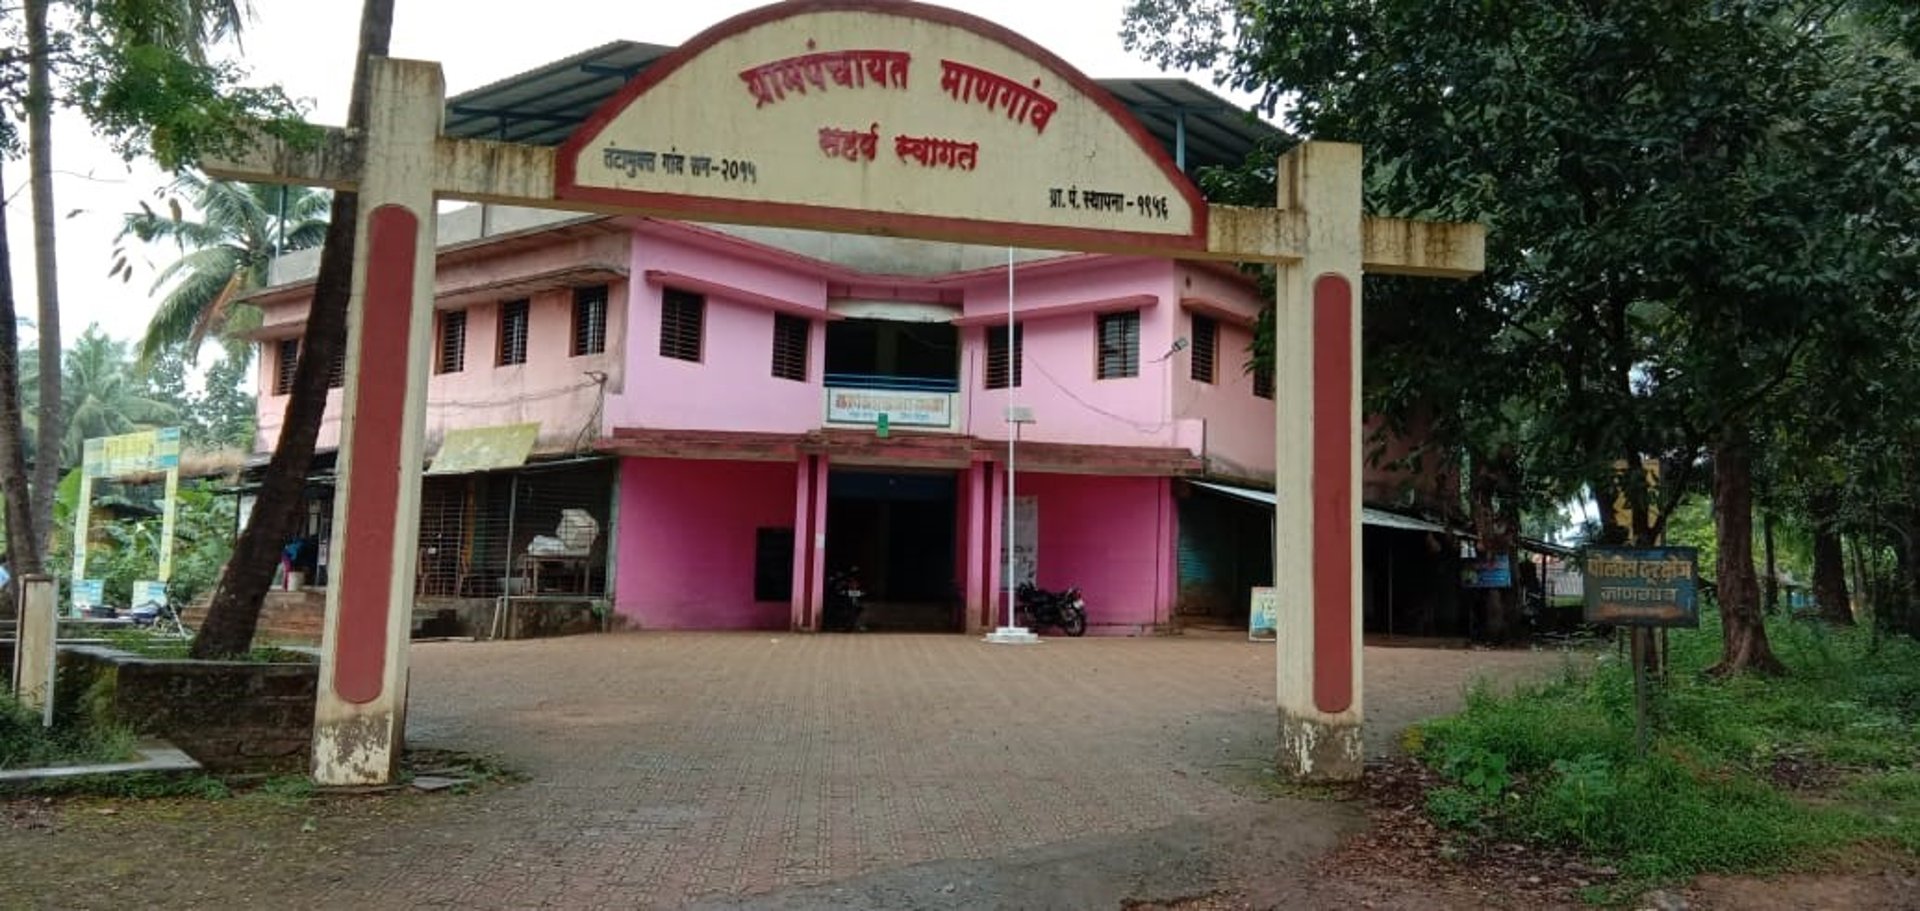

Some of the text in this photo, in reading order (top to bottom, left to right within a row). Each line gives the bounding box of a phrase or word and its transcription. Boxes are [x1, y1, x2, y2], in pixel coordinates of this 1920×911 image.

[739, 38, 1058, 135] ग्रामपंचायत माणगांव
[662, 147, 684, 176] गांव
[895, 135, 979, 171] स्वागत
[1068, 185, 1081, 209] पं.
